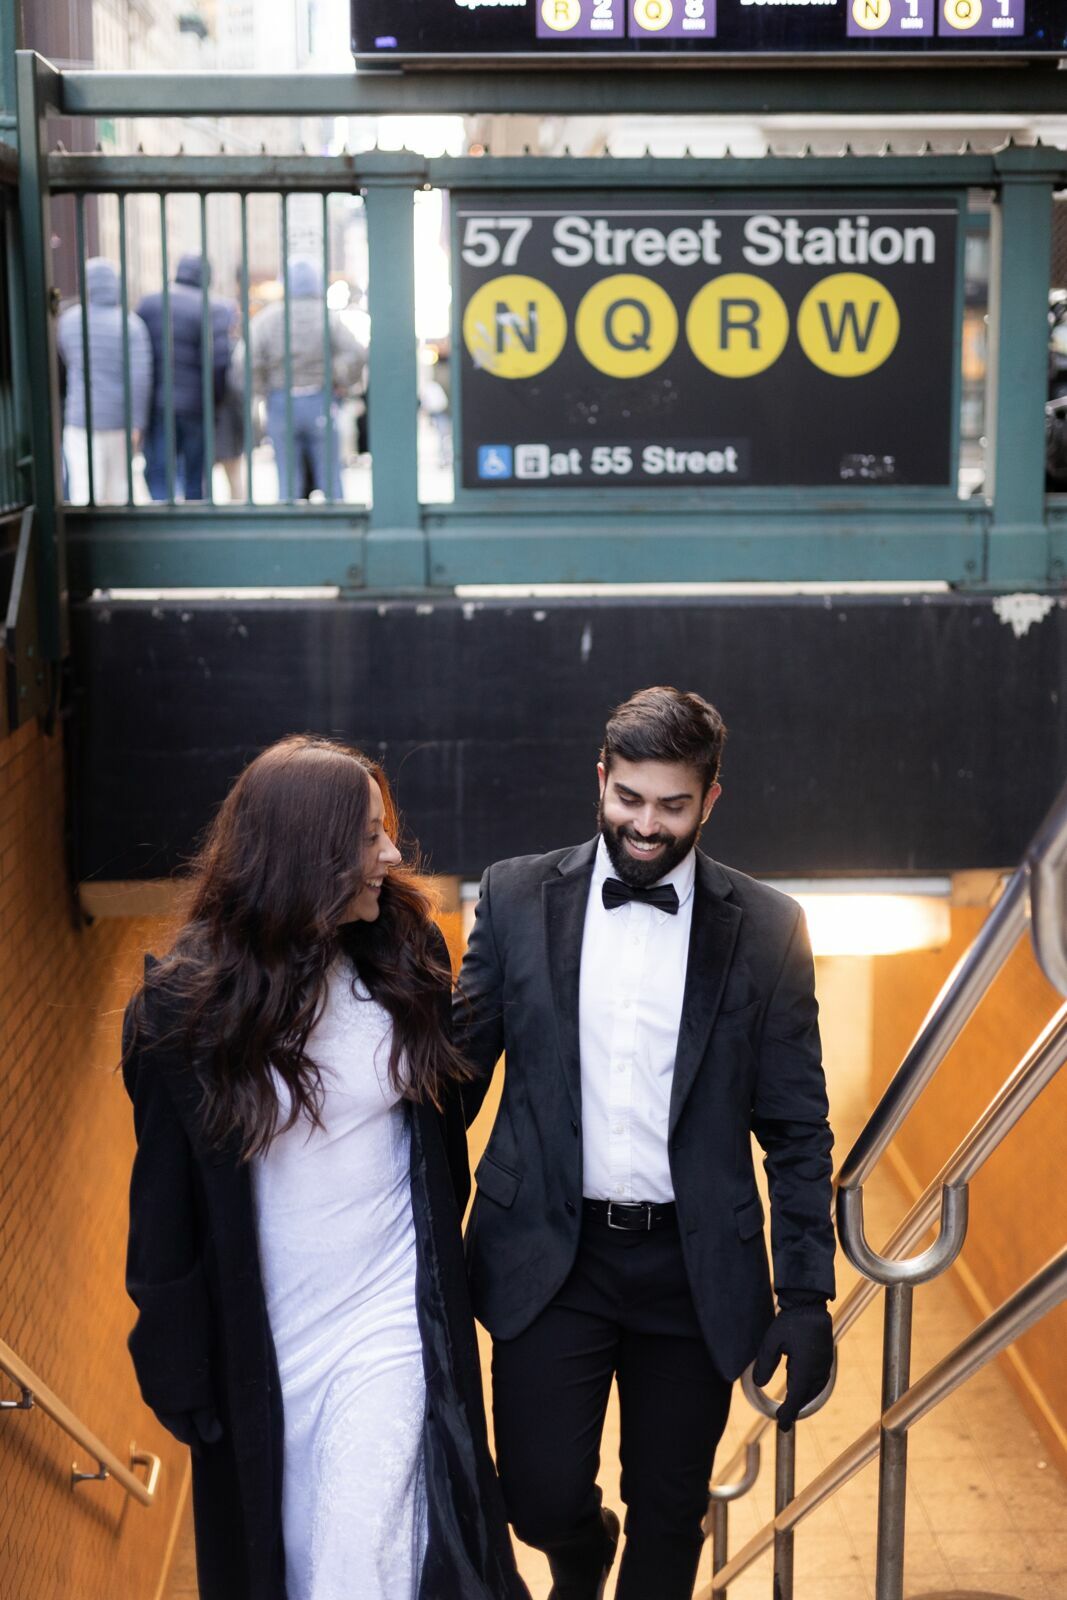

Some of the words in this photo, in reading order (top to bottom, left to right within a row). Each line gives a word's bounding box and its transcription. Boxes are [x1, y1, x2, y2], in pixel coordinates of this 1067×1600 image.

[554, 1, 569, 20] R
[592, 0, 613, 18] 2
[645, 1, 661, 20] Q
[684, 0, 705, 18] 8
[864, 0, 880, 17] N
[904, 0, 919, 17] 1
[954, 0, 973, 18] Q
[996, 0, 1010, 17] 1
[461, 217, 532, 267] 57
[552, 215, 722, 267] Street
[743, 214, 936, 265] Station
[497, 302, 536, 353] N
[605, 298, 651, 352] Q
[720, 298, 761, 350] R
[818, 301, 880, 353] W
[549, 447, 582, 476] at
[590, 446, 634, 476] 55
[642, 444, 738, 475] Street
